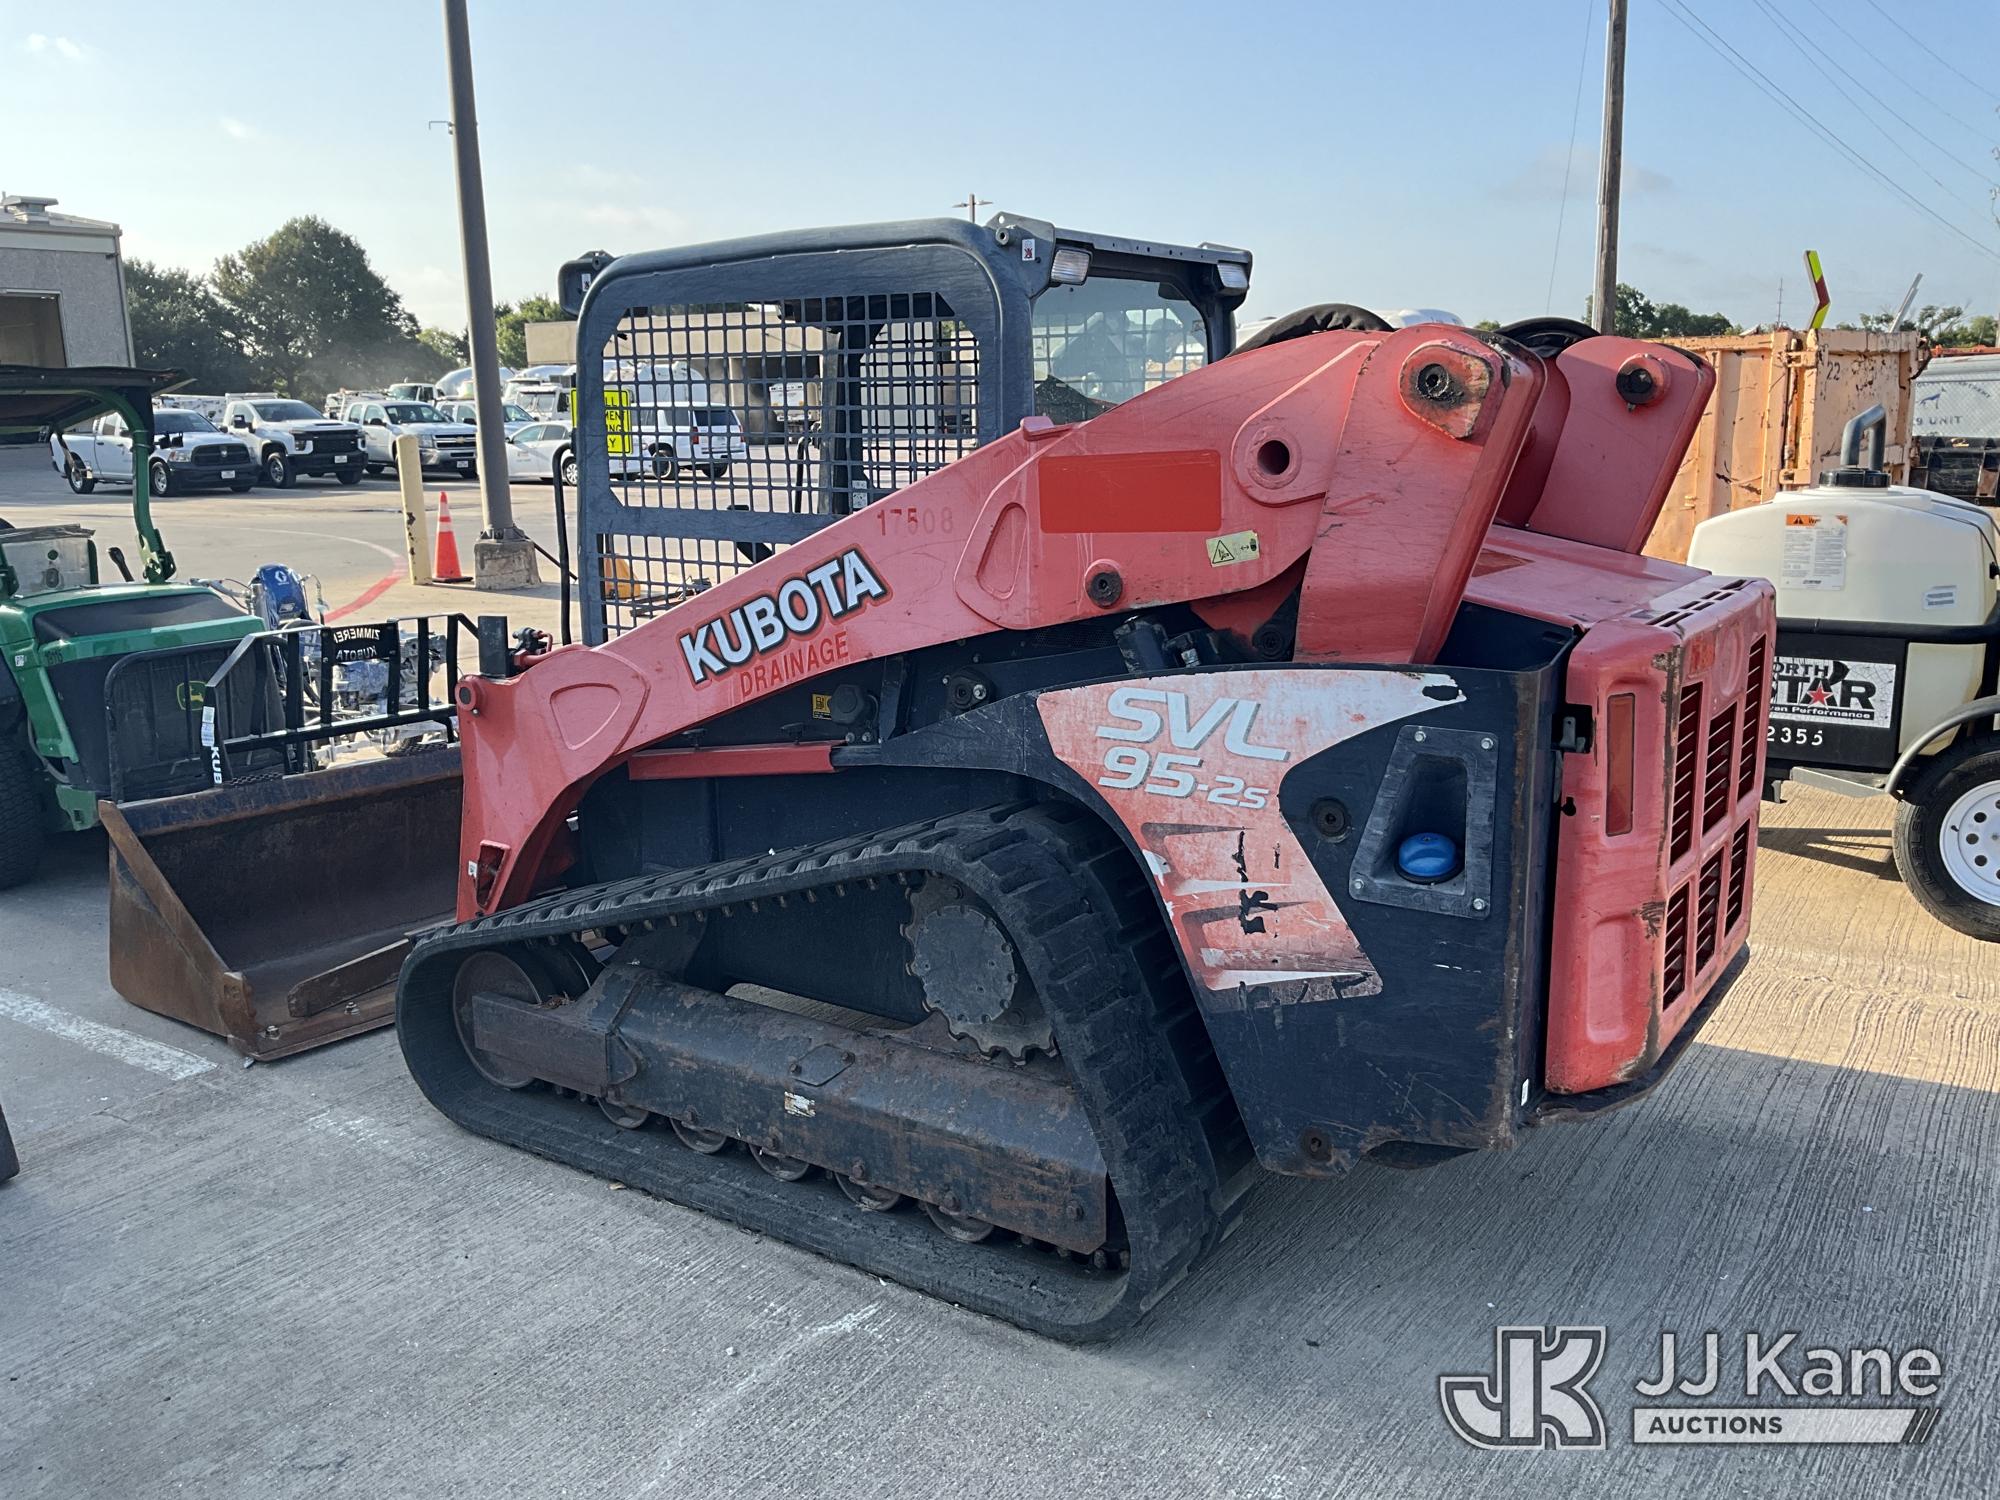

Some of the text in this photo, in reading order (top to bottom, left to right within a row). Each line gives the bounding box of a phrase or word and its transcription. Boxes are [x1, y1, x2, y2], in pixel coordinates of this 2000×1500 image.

[1928, 414, 1963, 426] UNIT
[876, 506, 954, 536] 17508
[679, 549, 885, 684] KUBOTA
[739, 630, 849, 698] DRAINAGE
[1771, 661, 1829, 677] ORTH
[1770, 674, 1876, 710] TAR
[1095, 686, 1291, 762] SVL
[1791, 706, 1871, 719] Performance
[1766, 725, 1823, 746] 2355
